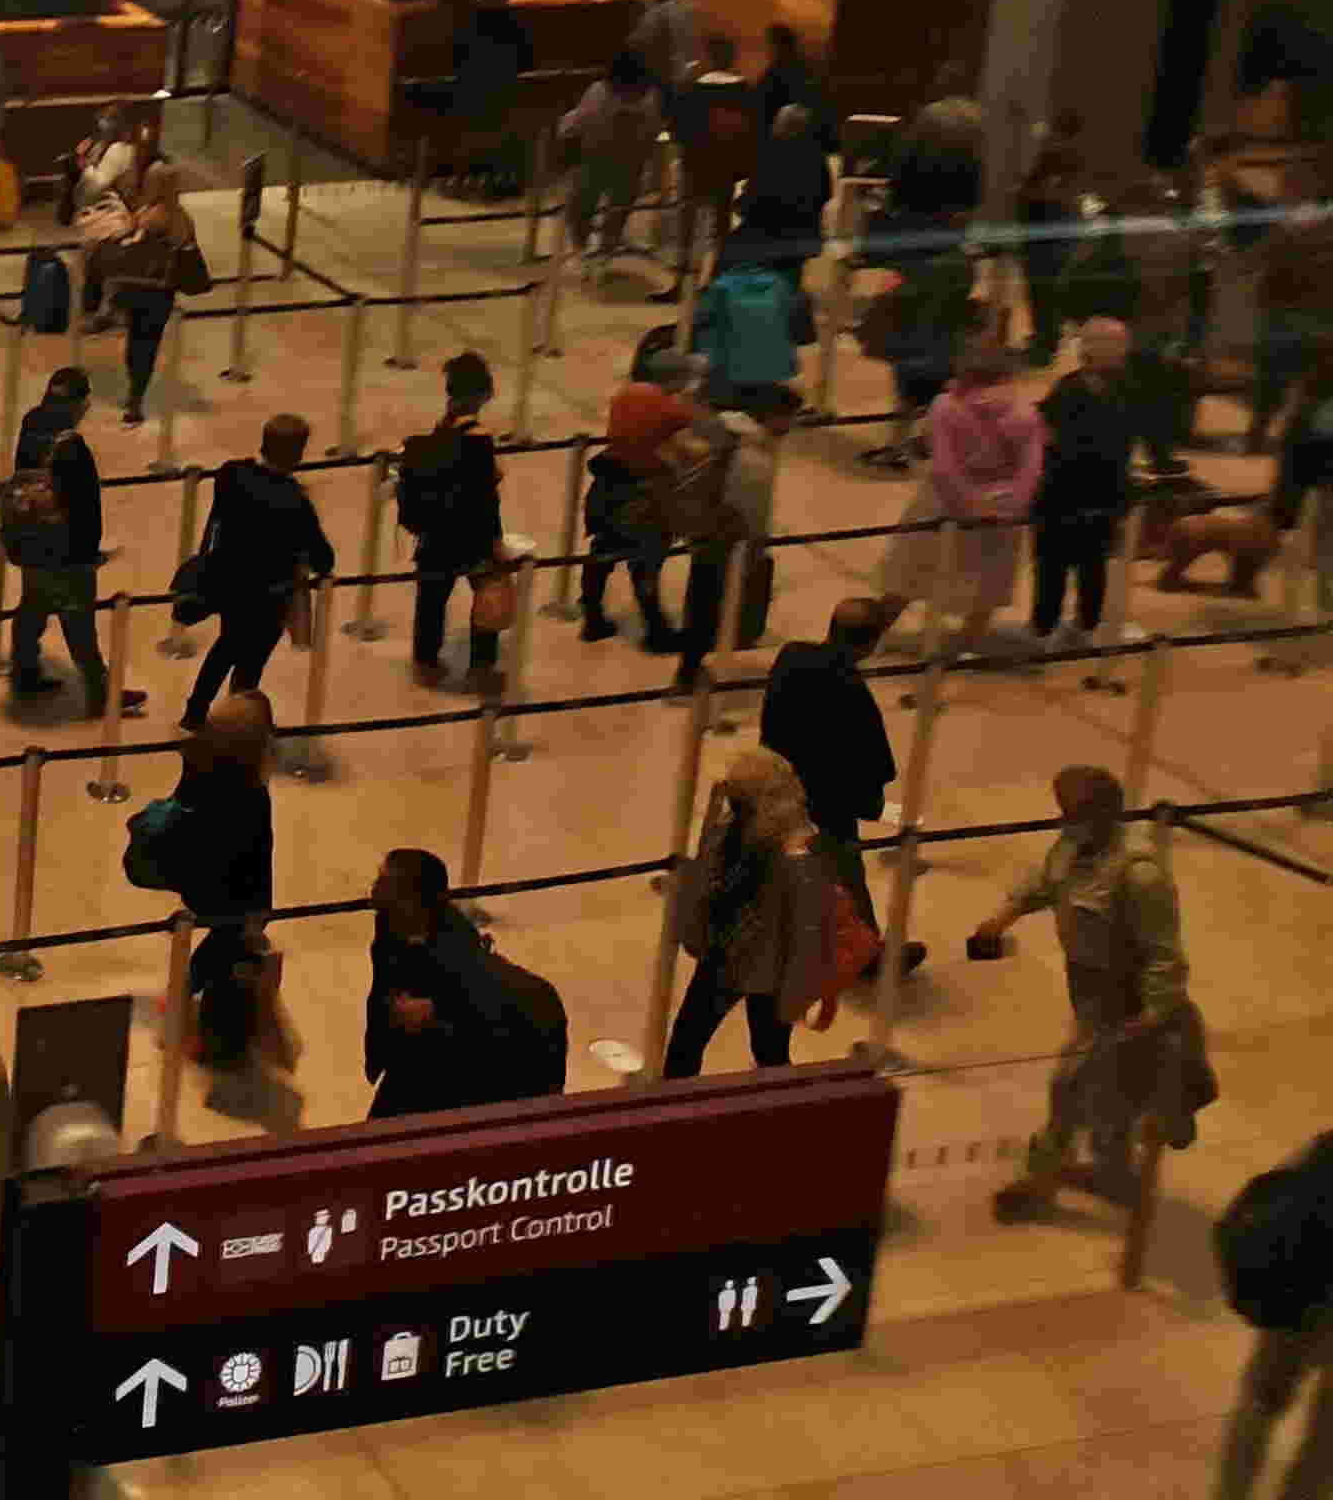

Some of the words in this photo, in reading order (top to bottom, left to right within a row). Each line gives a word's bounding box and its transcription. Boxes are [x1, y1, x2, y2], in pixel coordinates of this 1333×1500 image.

[385, 1157, 634, 1221] Passkontrolle
[380, 1221, 503, 1261] Passport
[510, 1204, 613, 1242] Control
[449, 1309, 531, 1343] Duty
[445, 1349, 517, 1378] Free
